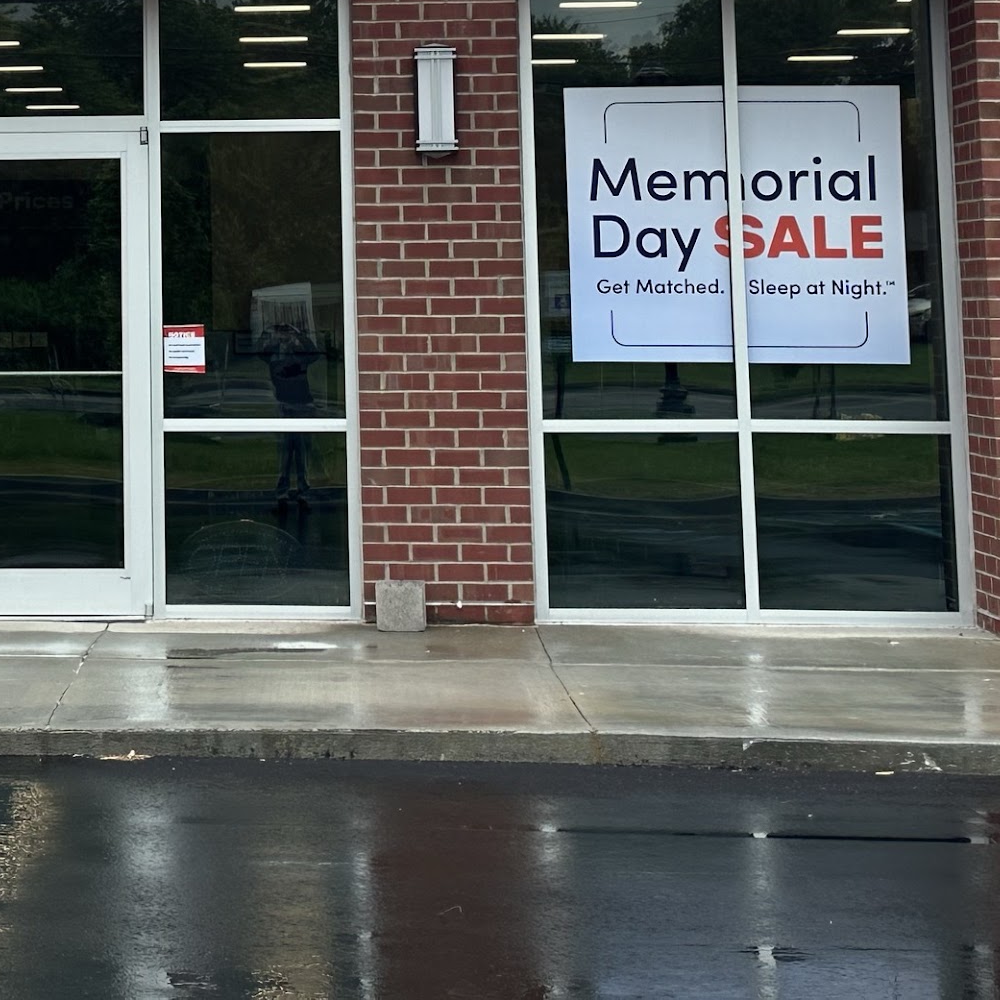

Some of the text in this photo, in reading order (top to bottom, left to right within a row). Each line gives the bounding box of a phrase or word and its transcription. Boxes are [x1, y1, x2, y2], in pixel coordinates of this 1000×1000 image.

[590, 155, 877, 201] Memorial
[592, 215, 884, 272] Day SALE
[596, 279, 630, 295] Get
[635, 279, 725, 295] Matched.
[749, 280, 801, 299] Sleep
[806, 281, 826, 295] at
